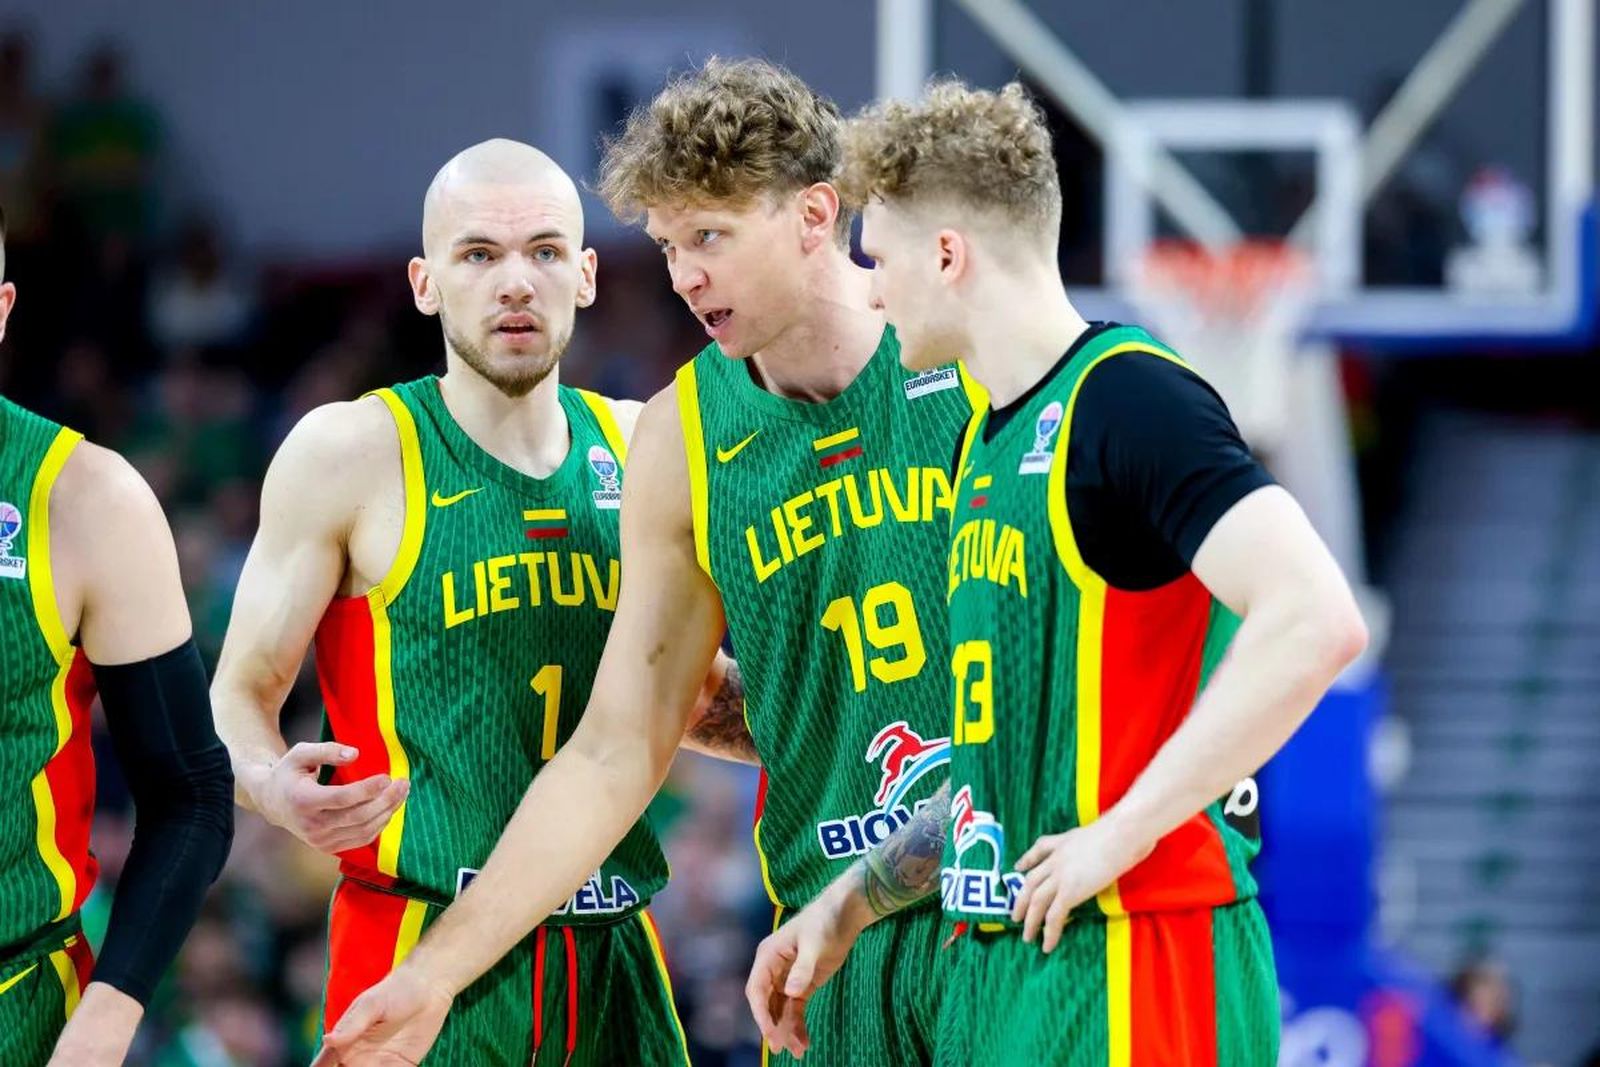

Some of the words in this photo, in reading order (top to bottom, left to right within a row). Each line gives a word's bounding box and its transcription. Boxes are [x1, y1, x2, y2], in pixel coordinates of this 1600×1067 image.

[745, 467, 953, 584] LIETUVA
[442, 551, 619, 629] LIETUV
[820, 581, 926, 693] 19
[530, 665, 562, 761] 1
